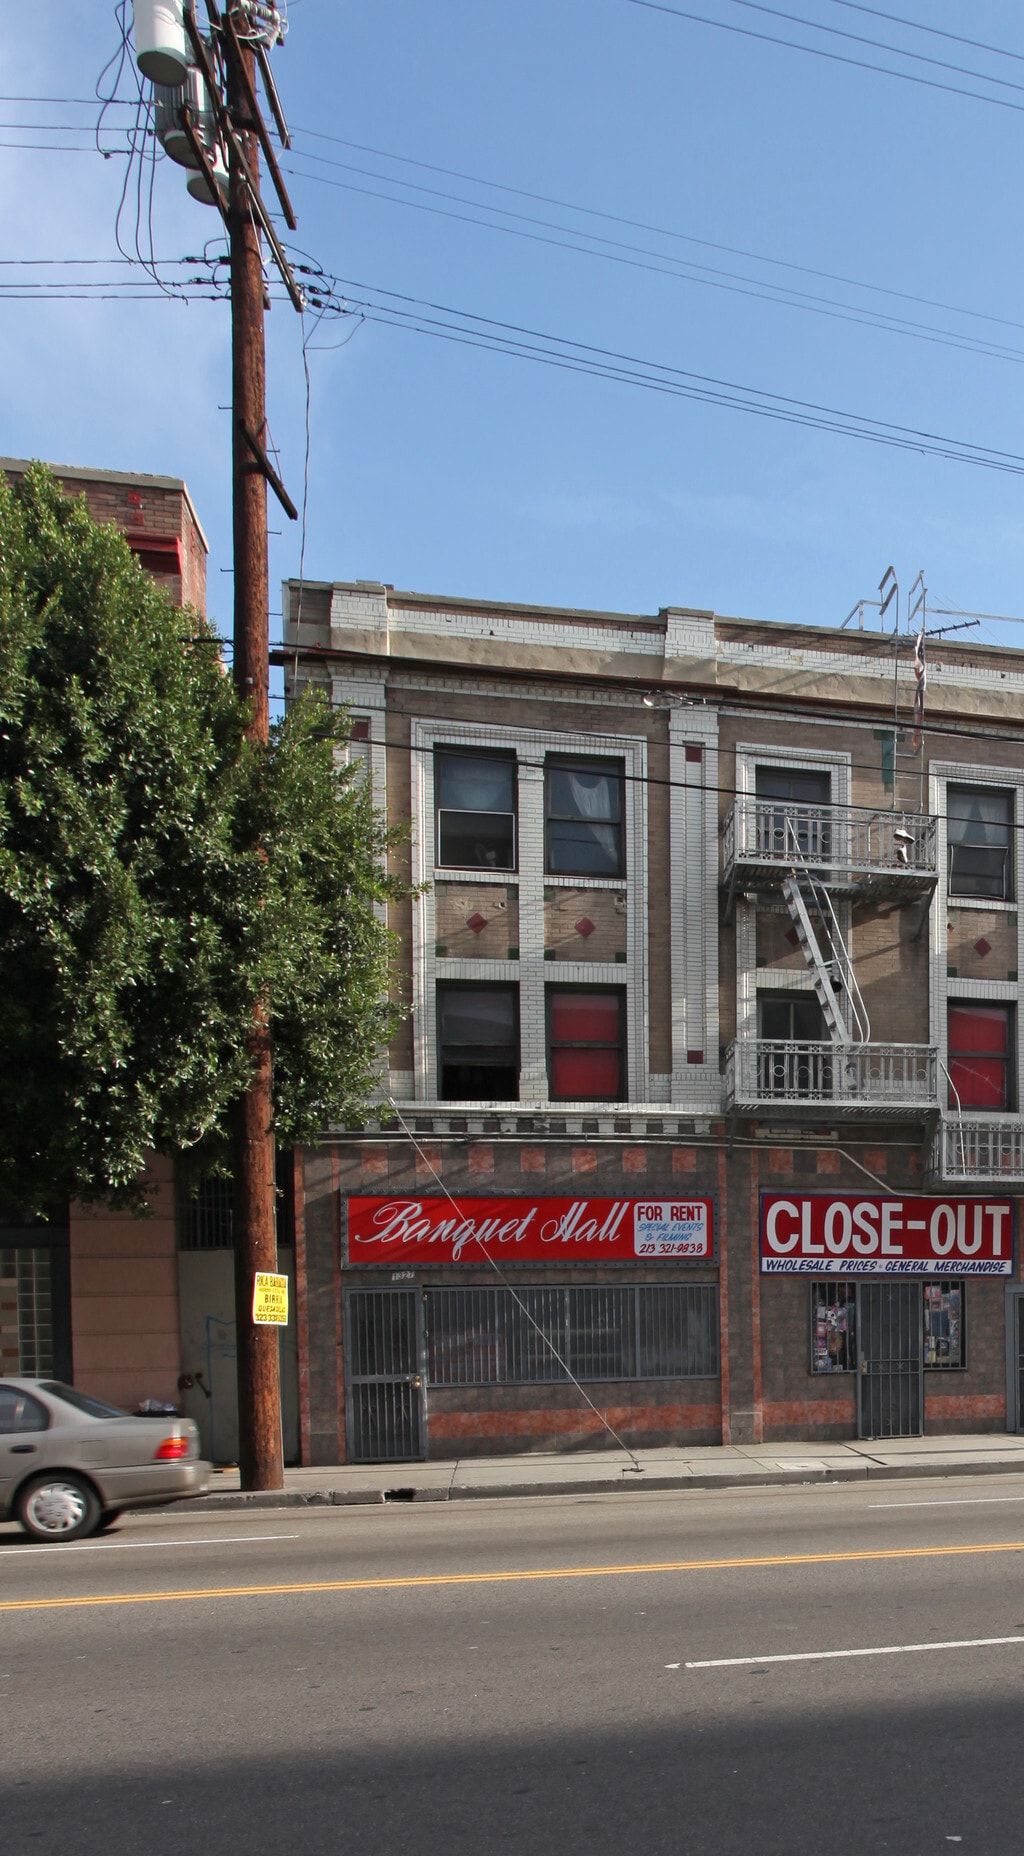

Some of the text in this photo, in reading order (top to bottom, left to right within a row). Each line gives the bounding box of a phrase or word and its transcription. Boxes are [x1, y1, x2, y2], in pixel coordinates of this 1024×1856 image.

[637, 1205, 703, 1221] FOR RENT
[355, 1201, 630, 1261] Banquet Hall
[638, 1223, 704, 1232] SPECIAL EVENTS
[766, 1200, 1010, 1256] CLOSE-OUT
[657, 1233, 692, 1241] FILMING
[639, 1243, 656, 1253] 213
[766, 1259, 1007, 1273] WHOLESALE PRICES GENERAL MERCHANDISE
